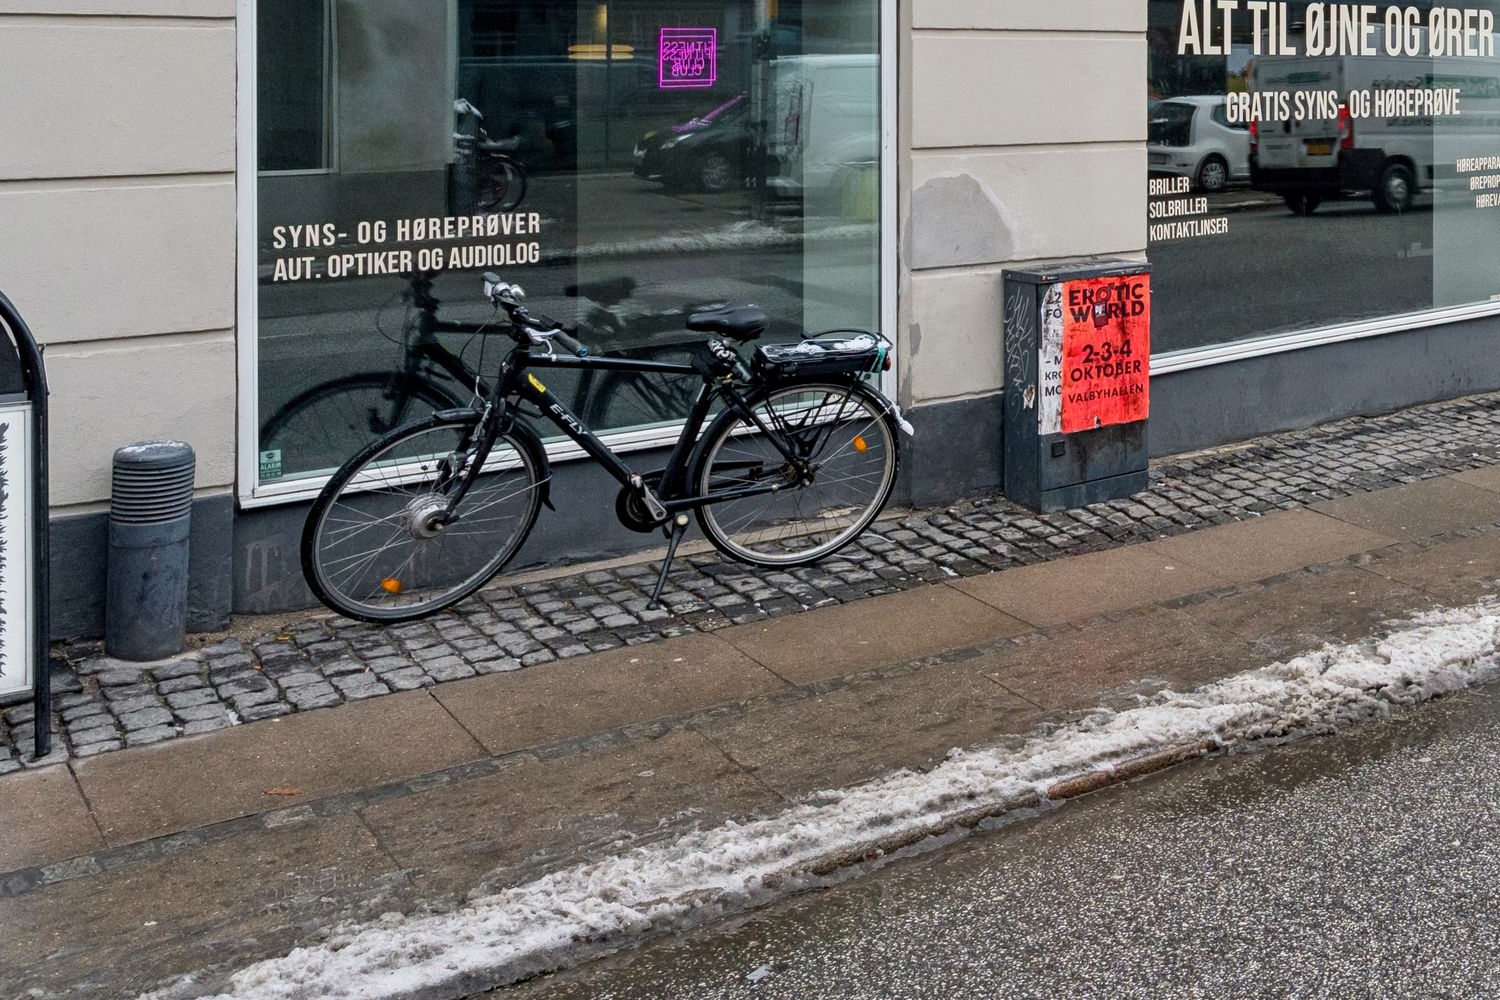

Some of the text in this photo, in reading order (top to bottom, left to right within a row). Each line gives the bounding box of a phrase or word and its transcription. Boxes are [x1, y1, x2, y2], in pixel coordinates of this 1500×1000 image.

[1247, 1, 1297, 56] TIL
[1305, 2, 1377, 57] ØJNE
[1385, 5, 1420, 57] OG
[1429, 6, 1494, 57] ØRER
[1226, 88, 1461, 123] GRATIS SYNS- OG HØREPRØVE
[1149, 176, 1190, 196] BRILLER
[1149, 197, 1208, 219] SOLBRILLER
[272, 212, 541, 249] SYNS- OG HØREPRØVER
[1149, 217, 1229, 242] KONTAKTLINSER
[272, 241, 541, 282] AUT. OPTIKER OG AUDIOLOG
[1068, 281, 1144, 307] EROTIC
[1069, 300, 1146, 324] WRLD
[1081, 338, 1132, 364] 2-3-4
[1070, 359, 1142, 382] OKTOBER
[1068, 383, 1144, 404] VALBYHALLEN
[549, 403, 589, 435] E-FLY
